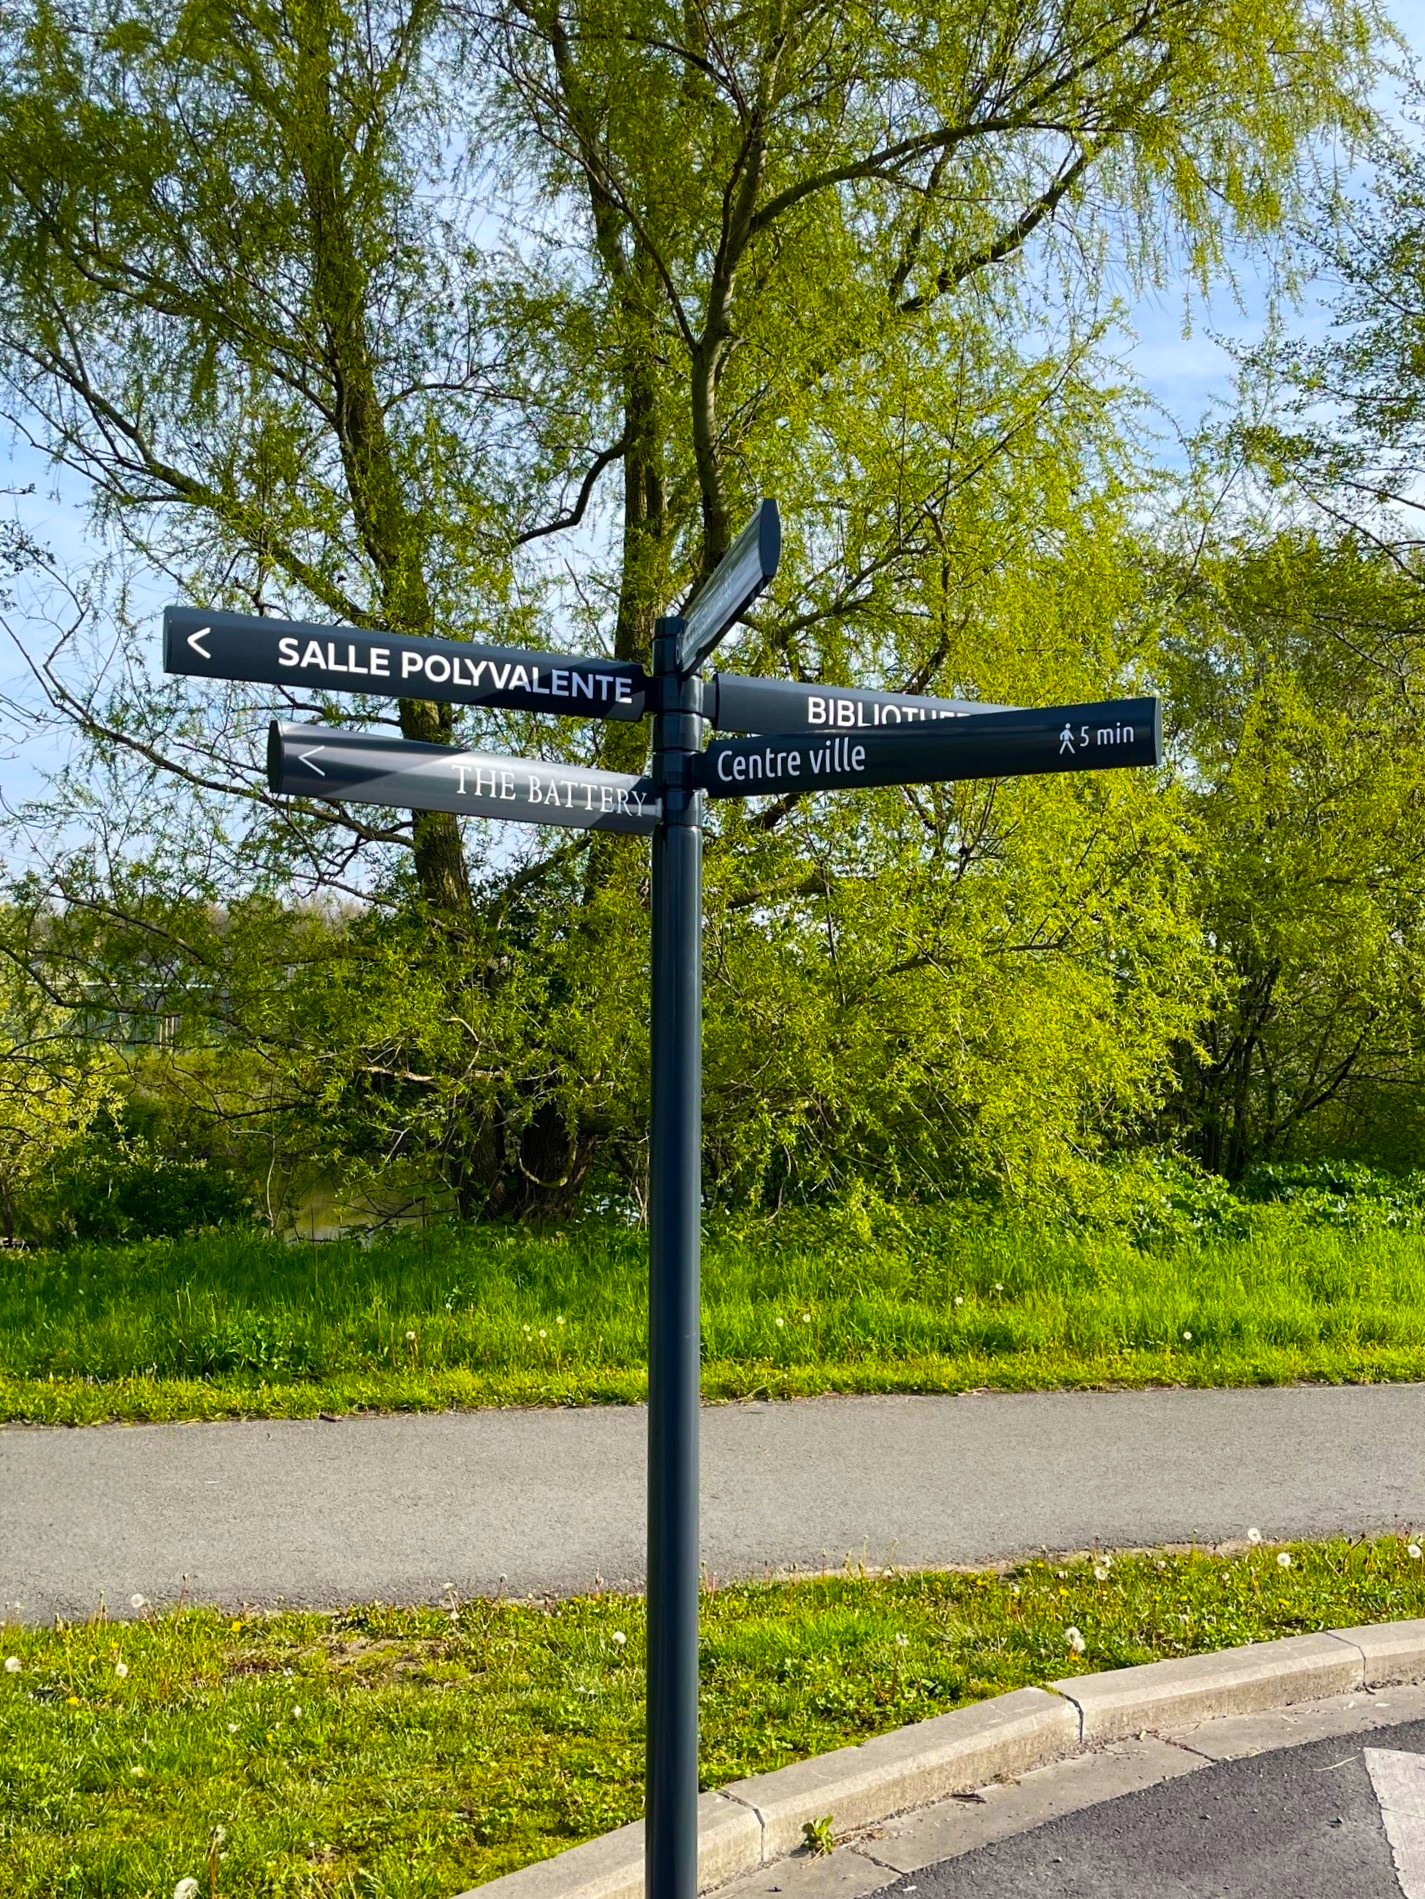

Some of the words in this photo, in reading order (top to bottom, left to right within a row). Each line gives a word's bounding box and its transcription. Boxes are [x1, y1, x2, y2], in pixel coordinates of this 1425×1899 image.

[277, 636, 391, 677] SALLE
[401, 650, 633, 703] POLYVALENTE
[808, 696, 972, 727] BIBLIOT
[1080, 726, 1089, 747] 5
[1097, 722, 1135, 746] min
[718, 748, 800, 782] Centre
[808, 737, 866, 775] ville
[453, 766, 517, 800] THE
[528, 777, 648, 818] BATTERY
